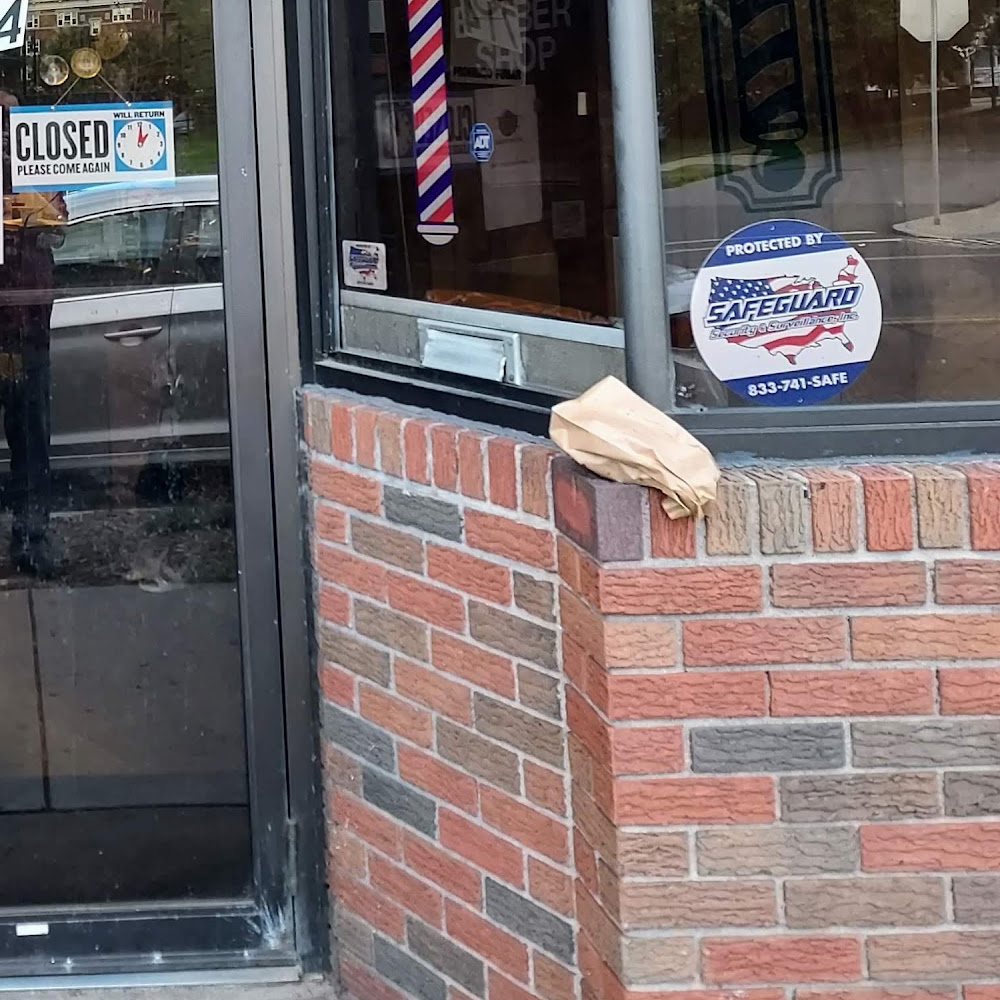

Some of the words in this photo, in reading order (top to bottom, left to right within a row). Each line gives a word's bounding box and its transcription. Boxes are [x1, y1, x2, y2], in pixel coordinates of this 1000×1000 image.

[15, 120, 109, 161] CLOSED
[473, 134, 490, 149] ADT
[17, 164, 51, 176] PLEASE
[53, 163, 81, 174] COME
[82, 161, 110, 173] AGAIN
[725, 236, 801, 257] PROTECTED
[805, 232, 824, 246] BY
[706, 285, 860, 324] SAFEGUARD
[709, 325, 757, 340] Security
[747, 372, 848, 397] 833-741-SAFE
